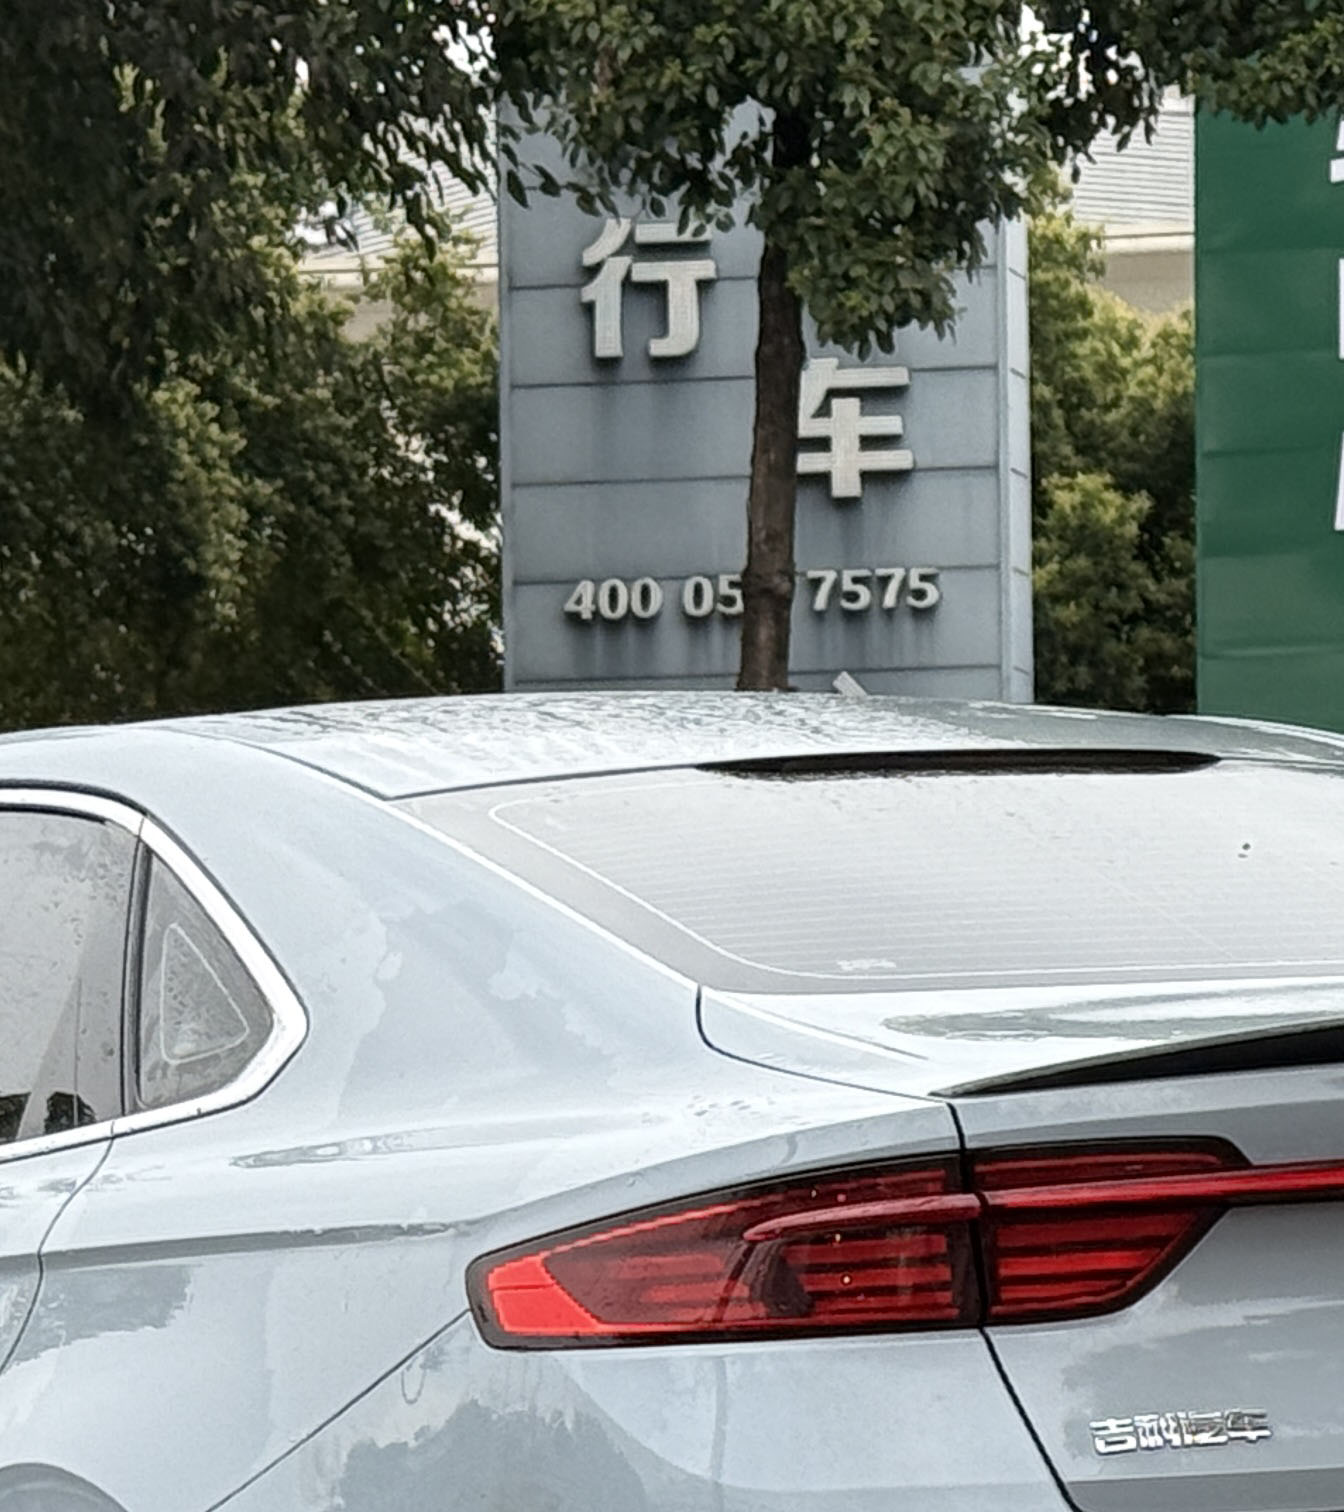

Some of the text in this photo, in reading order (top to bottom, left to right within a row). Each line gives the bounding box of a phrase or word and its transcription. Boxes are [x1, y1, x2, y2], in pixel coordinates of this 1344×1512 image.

[564, 567, 941, 620] 400 05 7575
[1088, 1408, 1272, 1456] 吉利汽车
